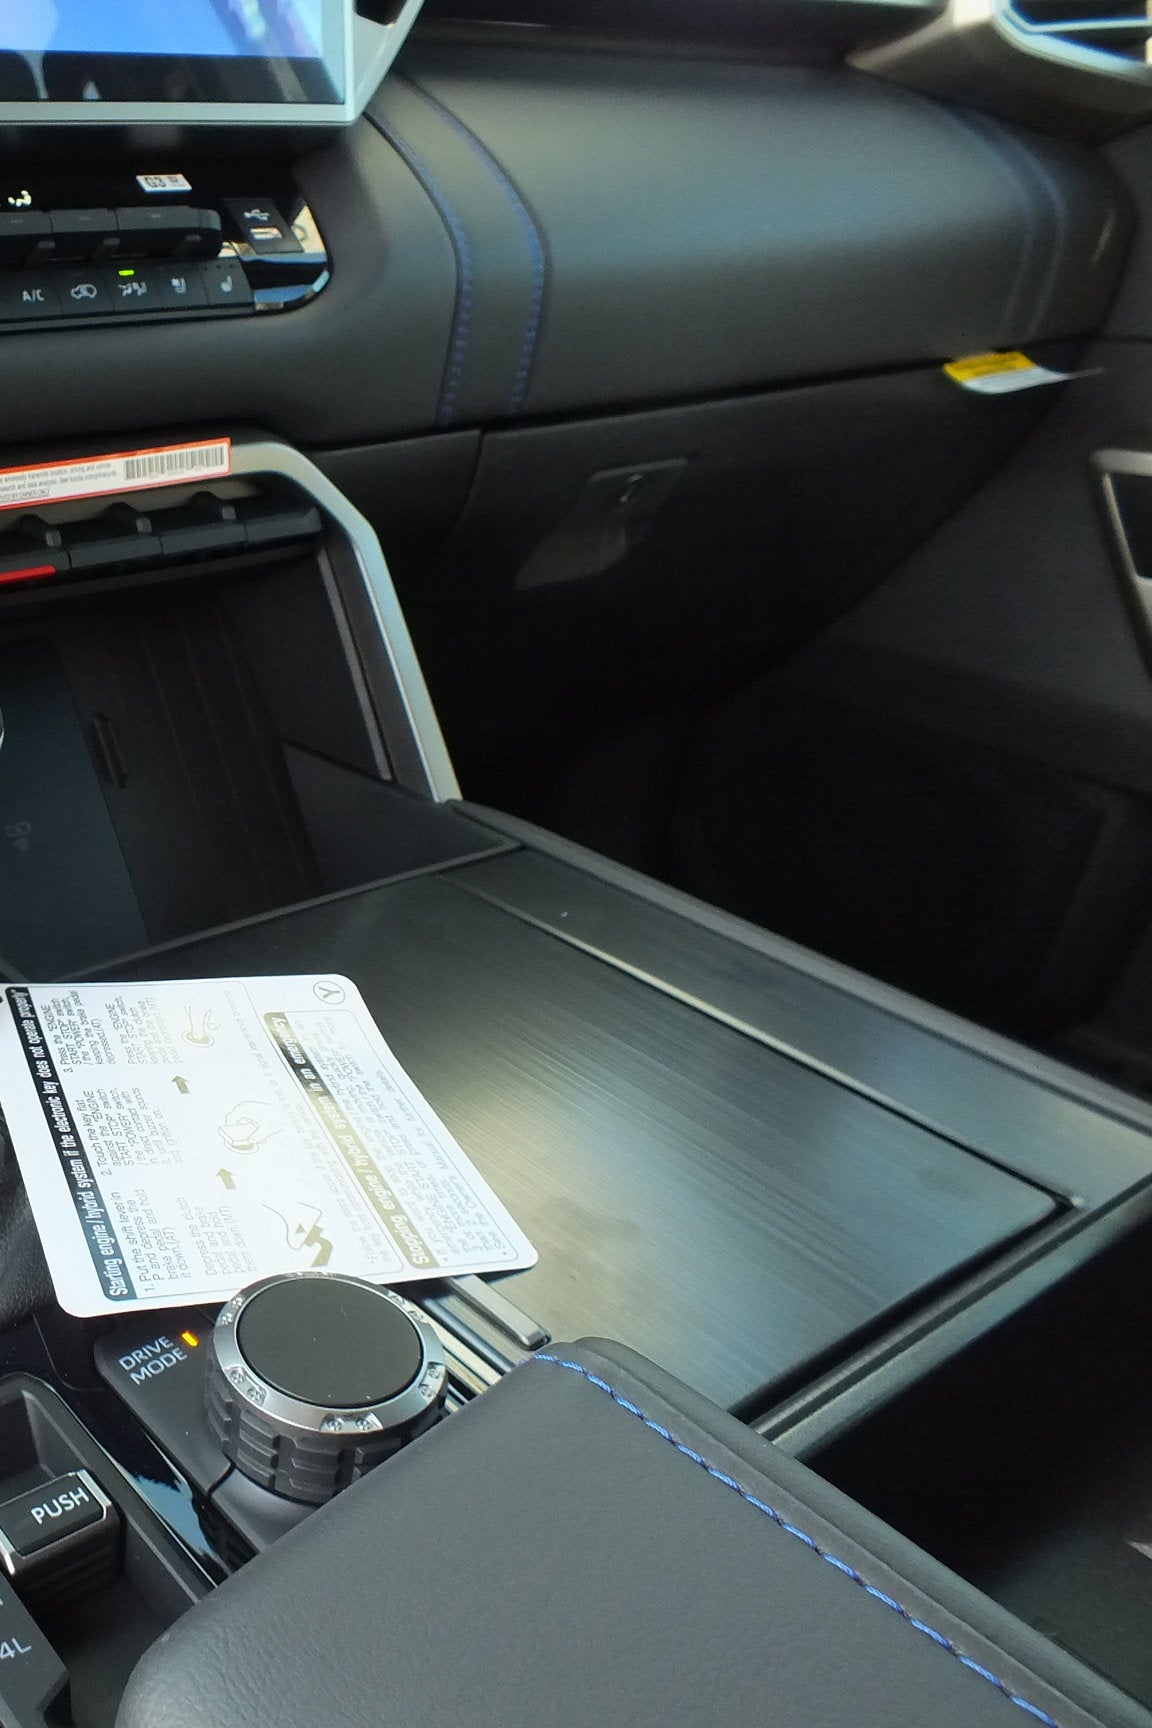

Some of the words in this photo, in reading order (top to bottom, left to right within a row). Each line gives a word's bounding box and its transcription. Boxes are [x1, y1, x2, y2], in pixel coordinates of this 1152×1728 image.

[22, 289, 45, 302] A/C
[318, 986, 340, 998] Y
[21, 1019, 42, 1043] operate
[53, 1034, 62, 1043] the
[271, 1017, 305, 1064] emergency
[28, 1046, 44, 1057] not
[57, 1047, 70, 1064] Press
[65, 1043, 81, 1064] START
[35, 1060, 51, 1077] does
[300, 1068, 315, 1079] an
[42, 1081, 58, 1093] key
[308, 1082, 323, 1091] in
[46, 1096, 70, 1132] electronic
[81, 1113, 93, 1126] key
[318, 1096, 346, 1129] system
[86, 1128, 98, 1140] the
[98, 1125, 109, 1136] the
[59, 1134, 76, 1147] the
[91, 1142, 106, 1166] Touch
[102, 1139, 121, 1165] against
[115, 1140, 134, 1165] START
[337, 1135, 368, 1166] hybrid
[70, 1159, 92, 1187] system
[110, 1191, 121, 1200] in
[133, 1188, 149, 1206] hold
[114, 1202, 129, 1222] lever
[126, 1199, 138, 1212] the
[142, 1208, 157, 1224] and
[121, 1225, 137, 1244] shift
[133, 1216, 152, 1249] depress
[149, 1228, 169, 1250] pedal
[390, 1215, 429, 1264] Stopping
[131, 1248, 144, 1263] the
[144, 1252, 160, 1269] and
[136, 1265, 151, 1281] Put
[162, 1255, 178, 1279] brake
[103, 1258, 127, 1295] Starting
[118, 1335, 175, 1372] DRIVE
[129, 1348, 189, 1385] MODE
[30, 1486, 90, 1525] PUSH
